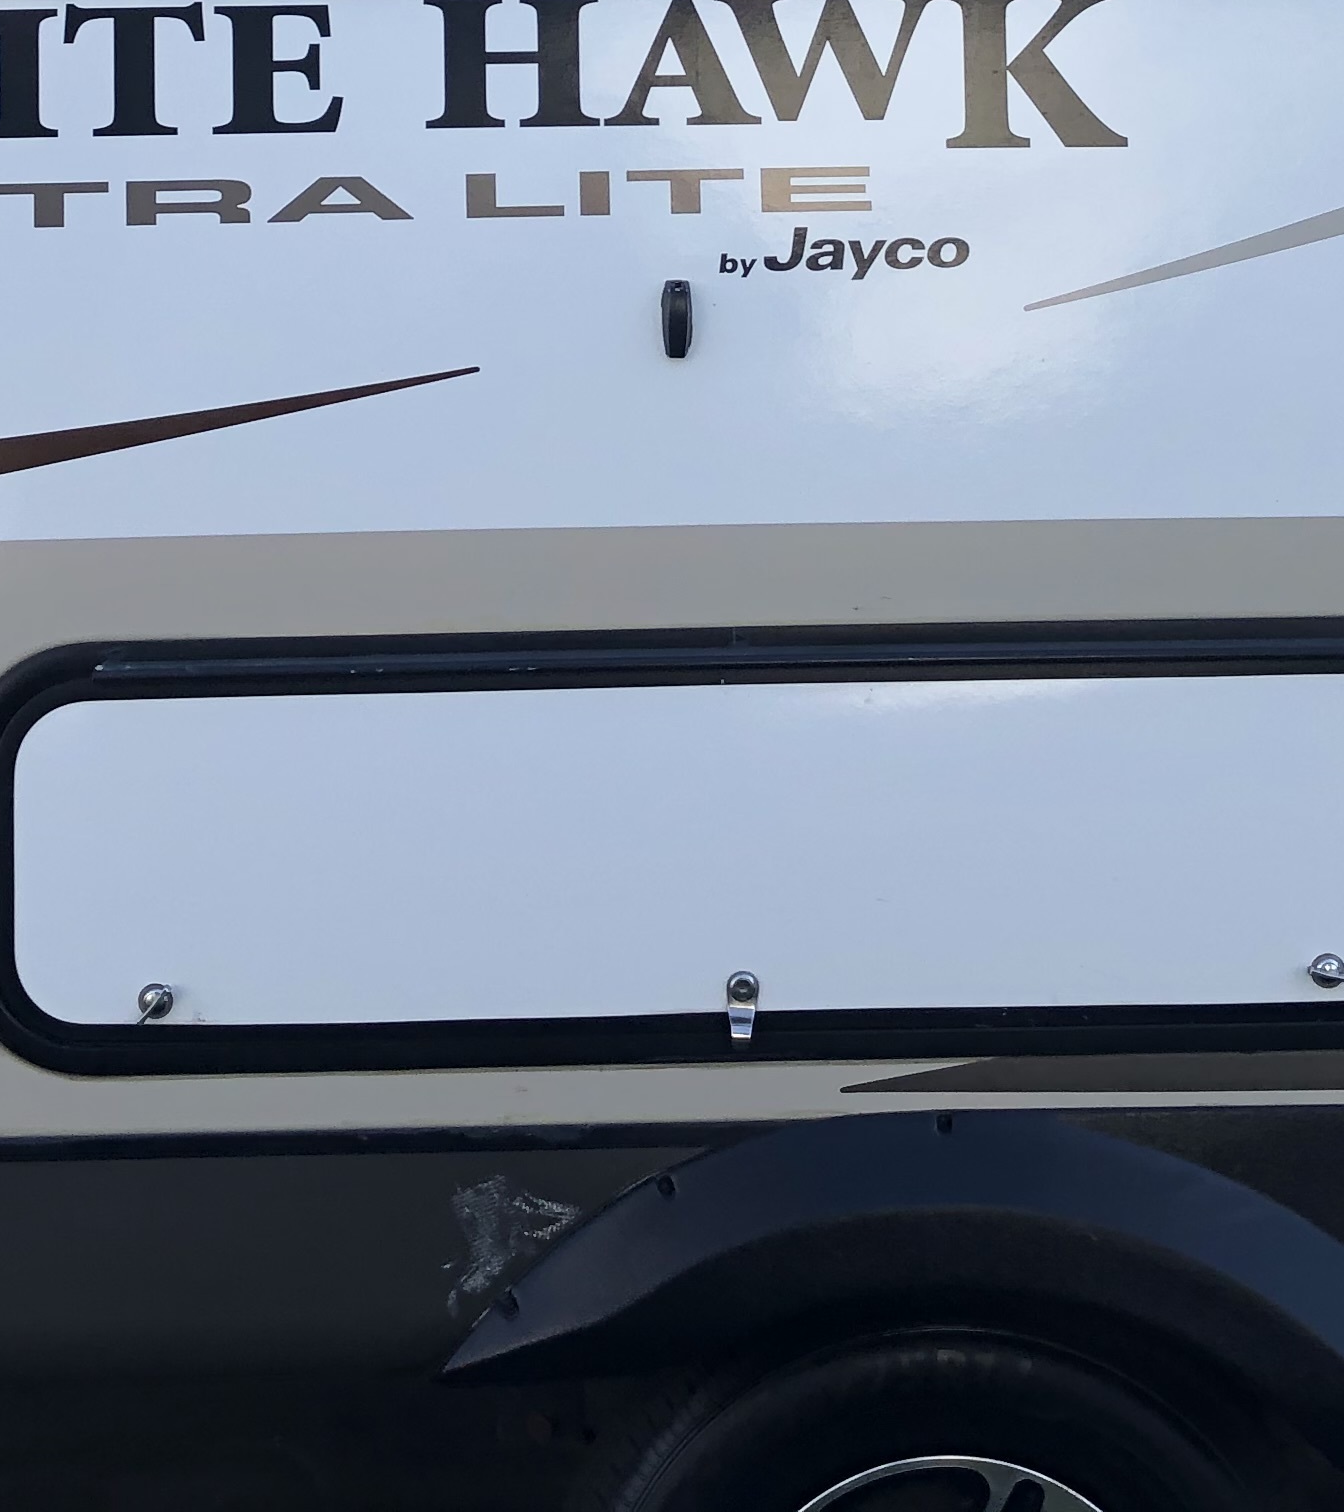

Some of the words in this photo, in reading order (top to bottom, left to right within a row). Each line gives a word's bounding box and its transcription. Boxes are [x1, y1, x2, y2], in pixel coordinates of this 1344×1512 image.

[466, 166, 872, 219] LITE
[719, 250, 757, 279] by
[763, 226, 971, 281] Jayco
